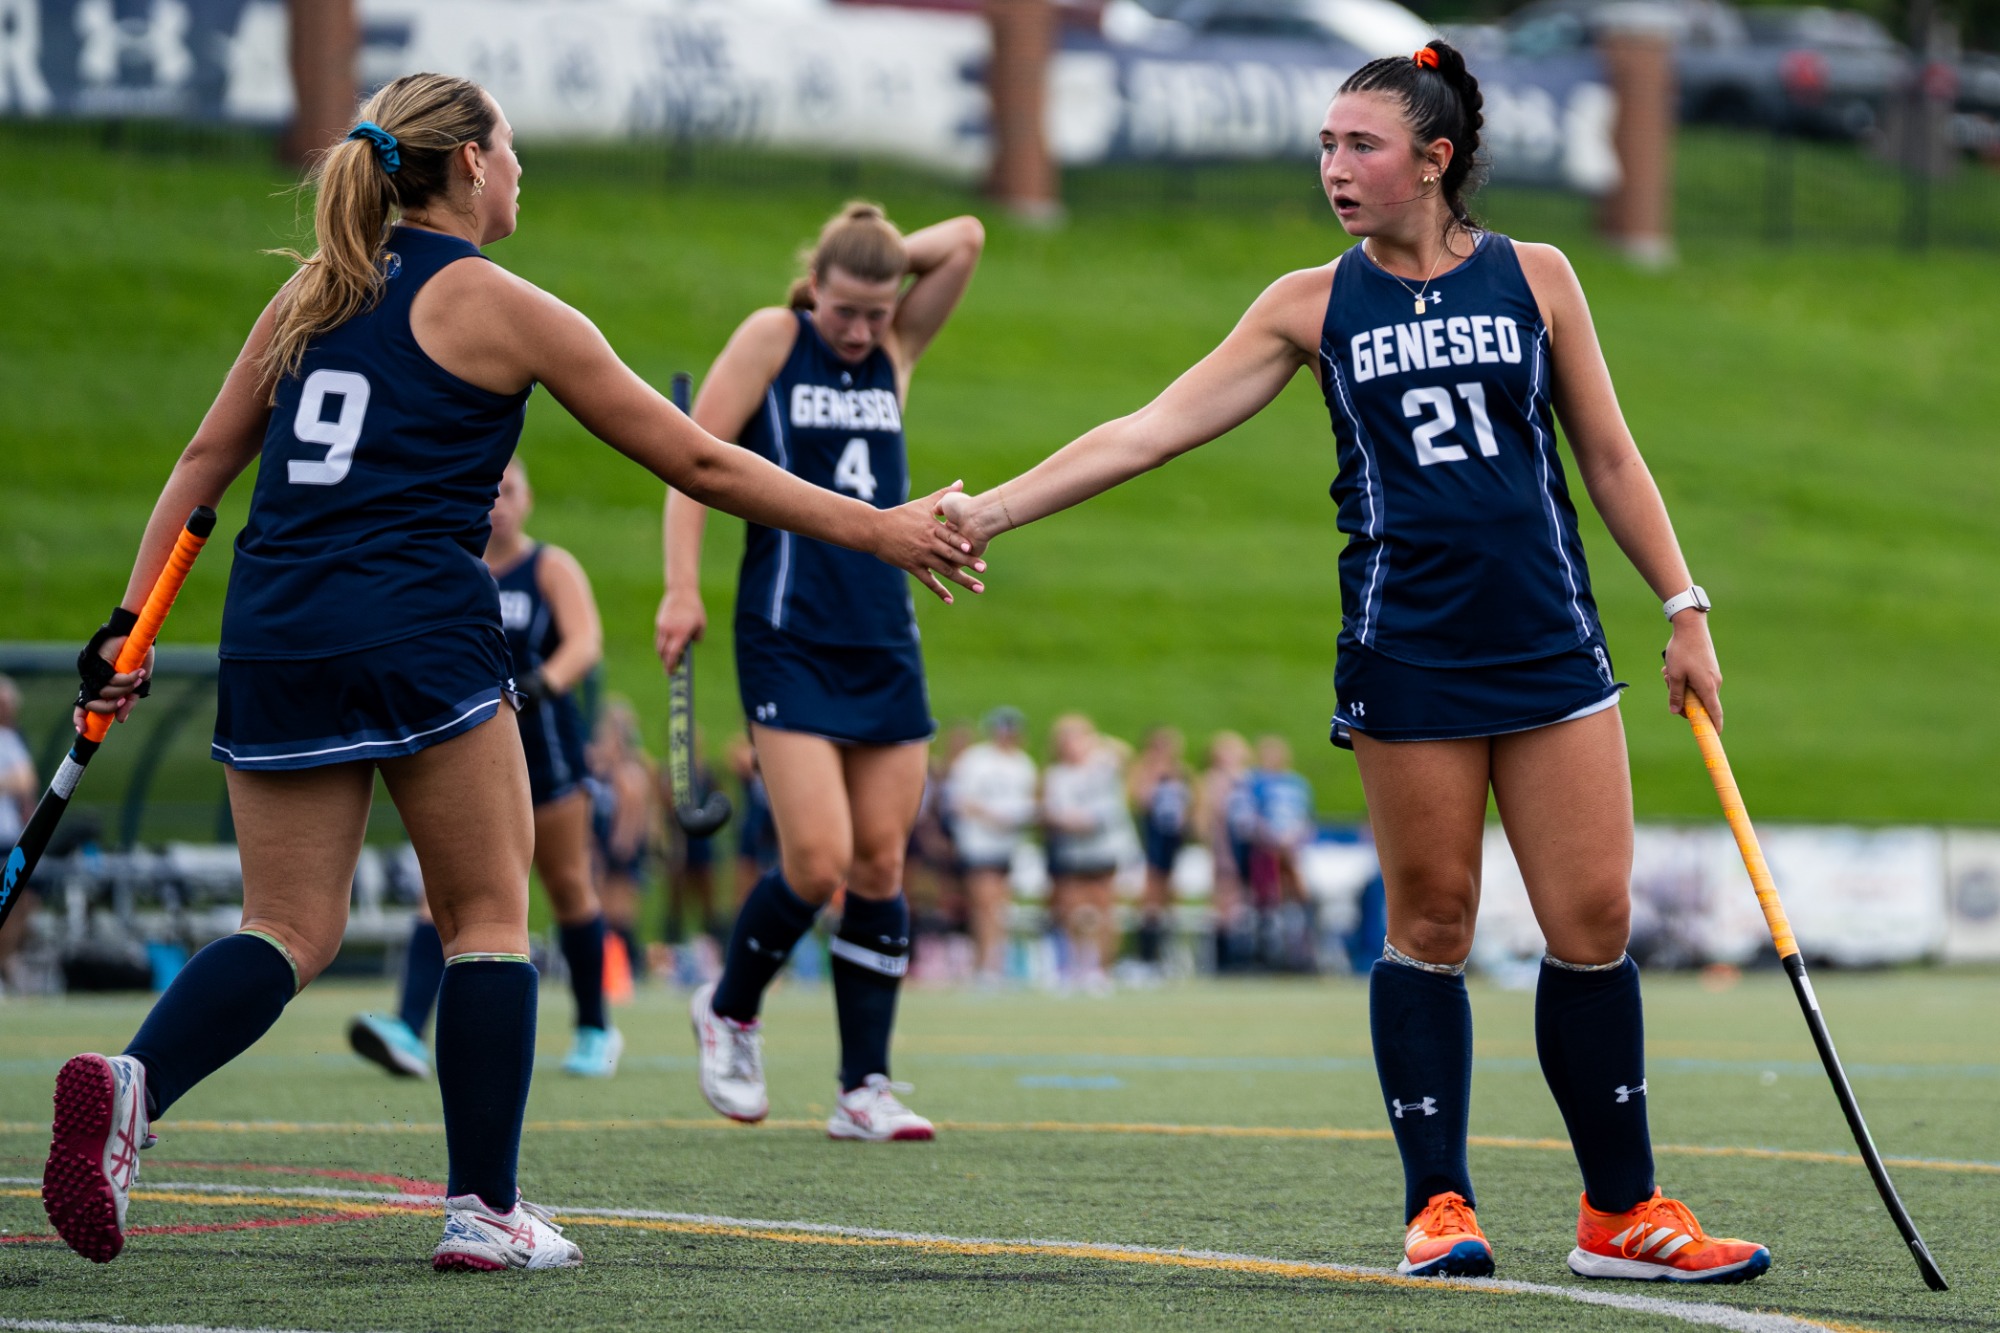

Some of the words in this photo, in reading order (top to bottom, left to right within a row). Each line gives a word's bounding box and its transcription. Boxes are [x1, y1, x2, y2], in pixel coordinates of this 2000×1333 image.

[1350, 315, 1522, 383] GENESEO
[287, 368, 371, 486] 9
[790, 383, 901, 432] GENESEO
[1401, 381, 1499, 466] 21
[834, 437, 877, 500] 4
